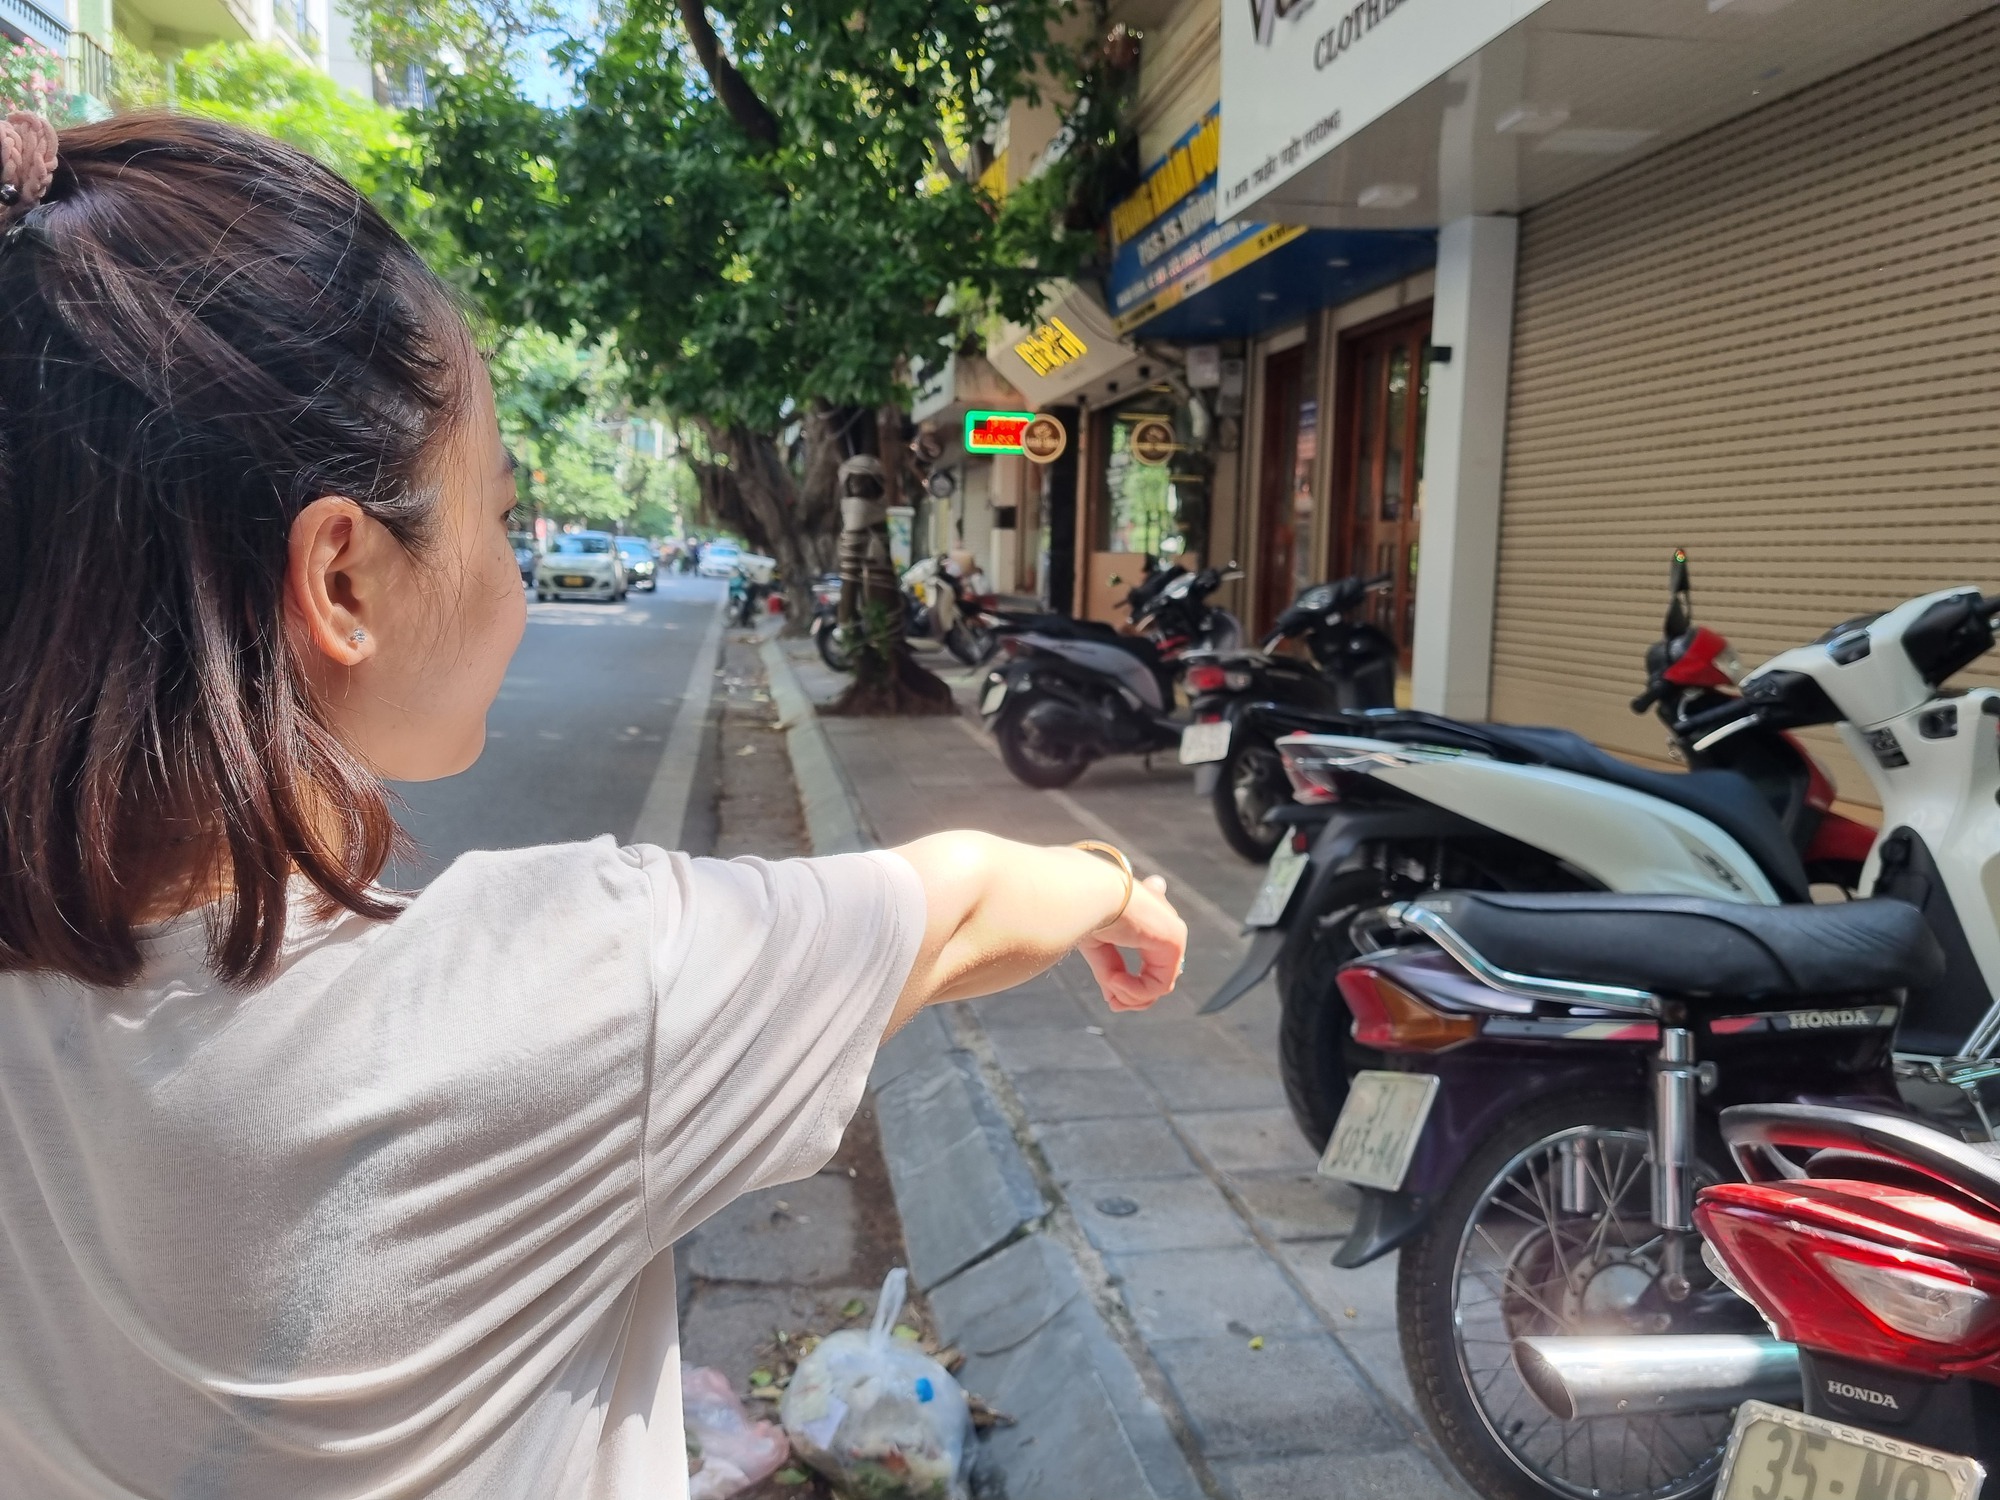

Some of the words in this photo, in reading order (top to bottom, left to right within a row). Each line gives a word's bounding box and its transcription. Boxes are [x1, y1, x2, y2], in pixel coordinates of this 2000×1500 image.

[1313, 0, 1407, 70] CLOTHE
[1788, 1009, 1869, 1030] HONDA
[1827, 1380, 1899, 1410] HONDA
